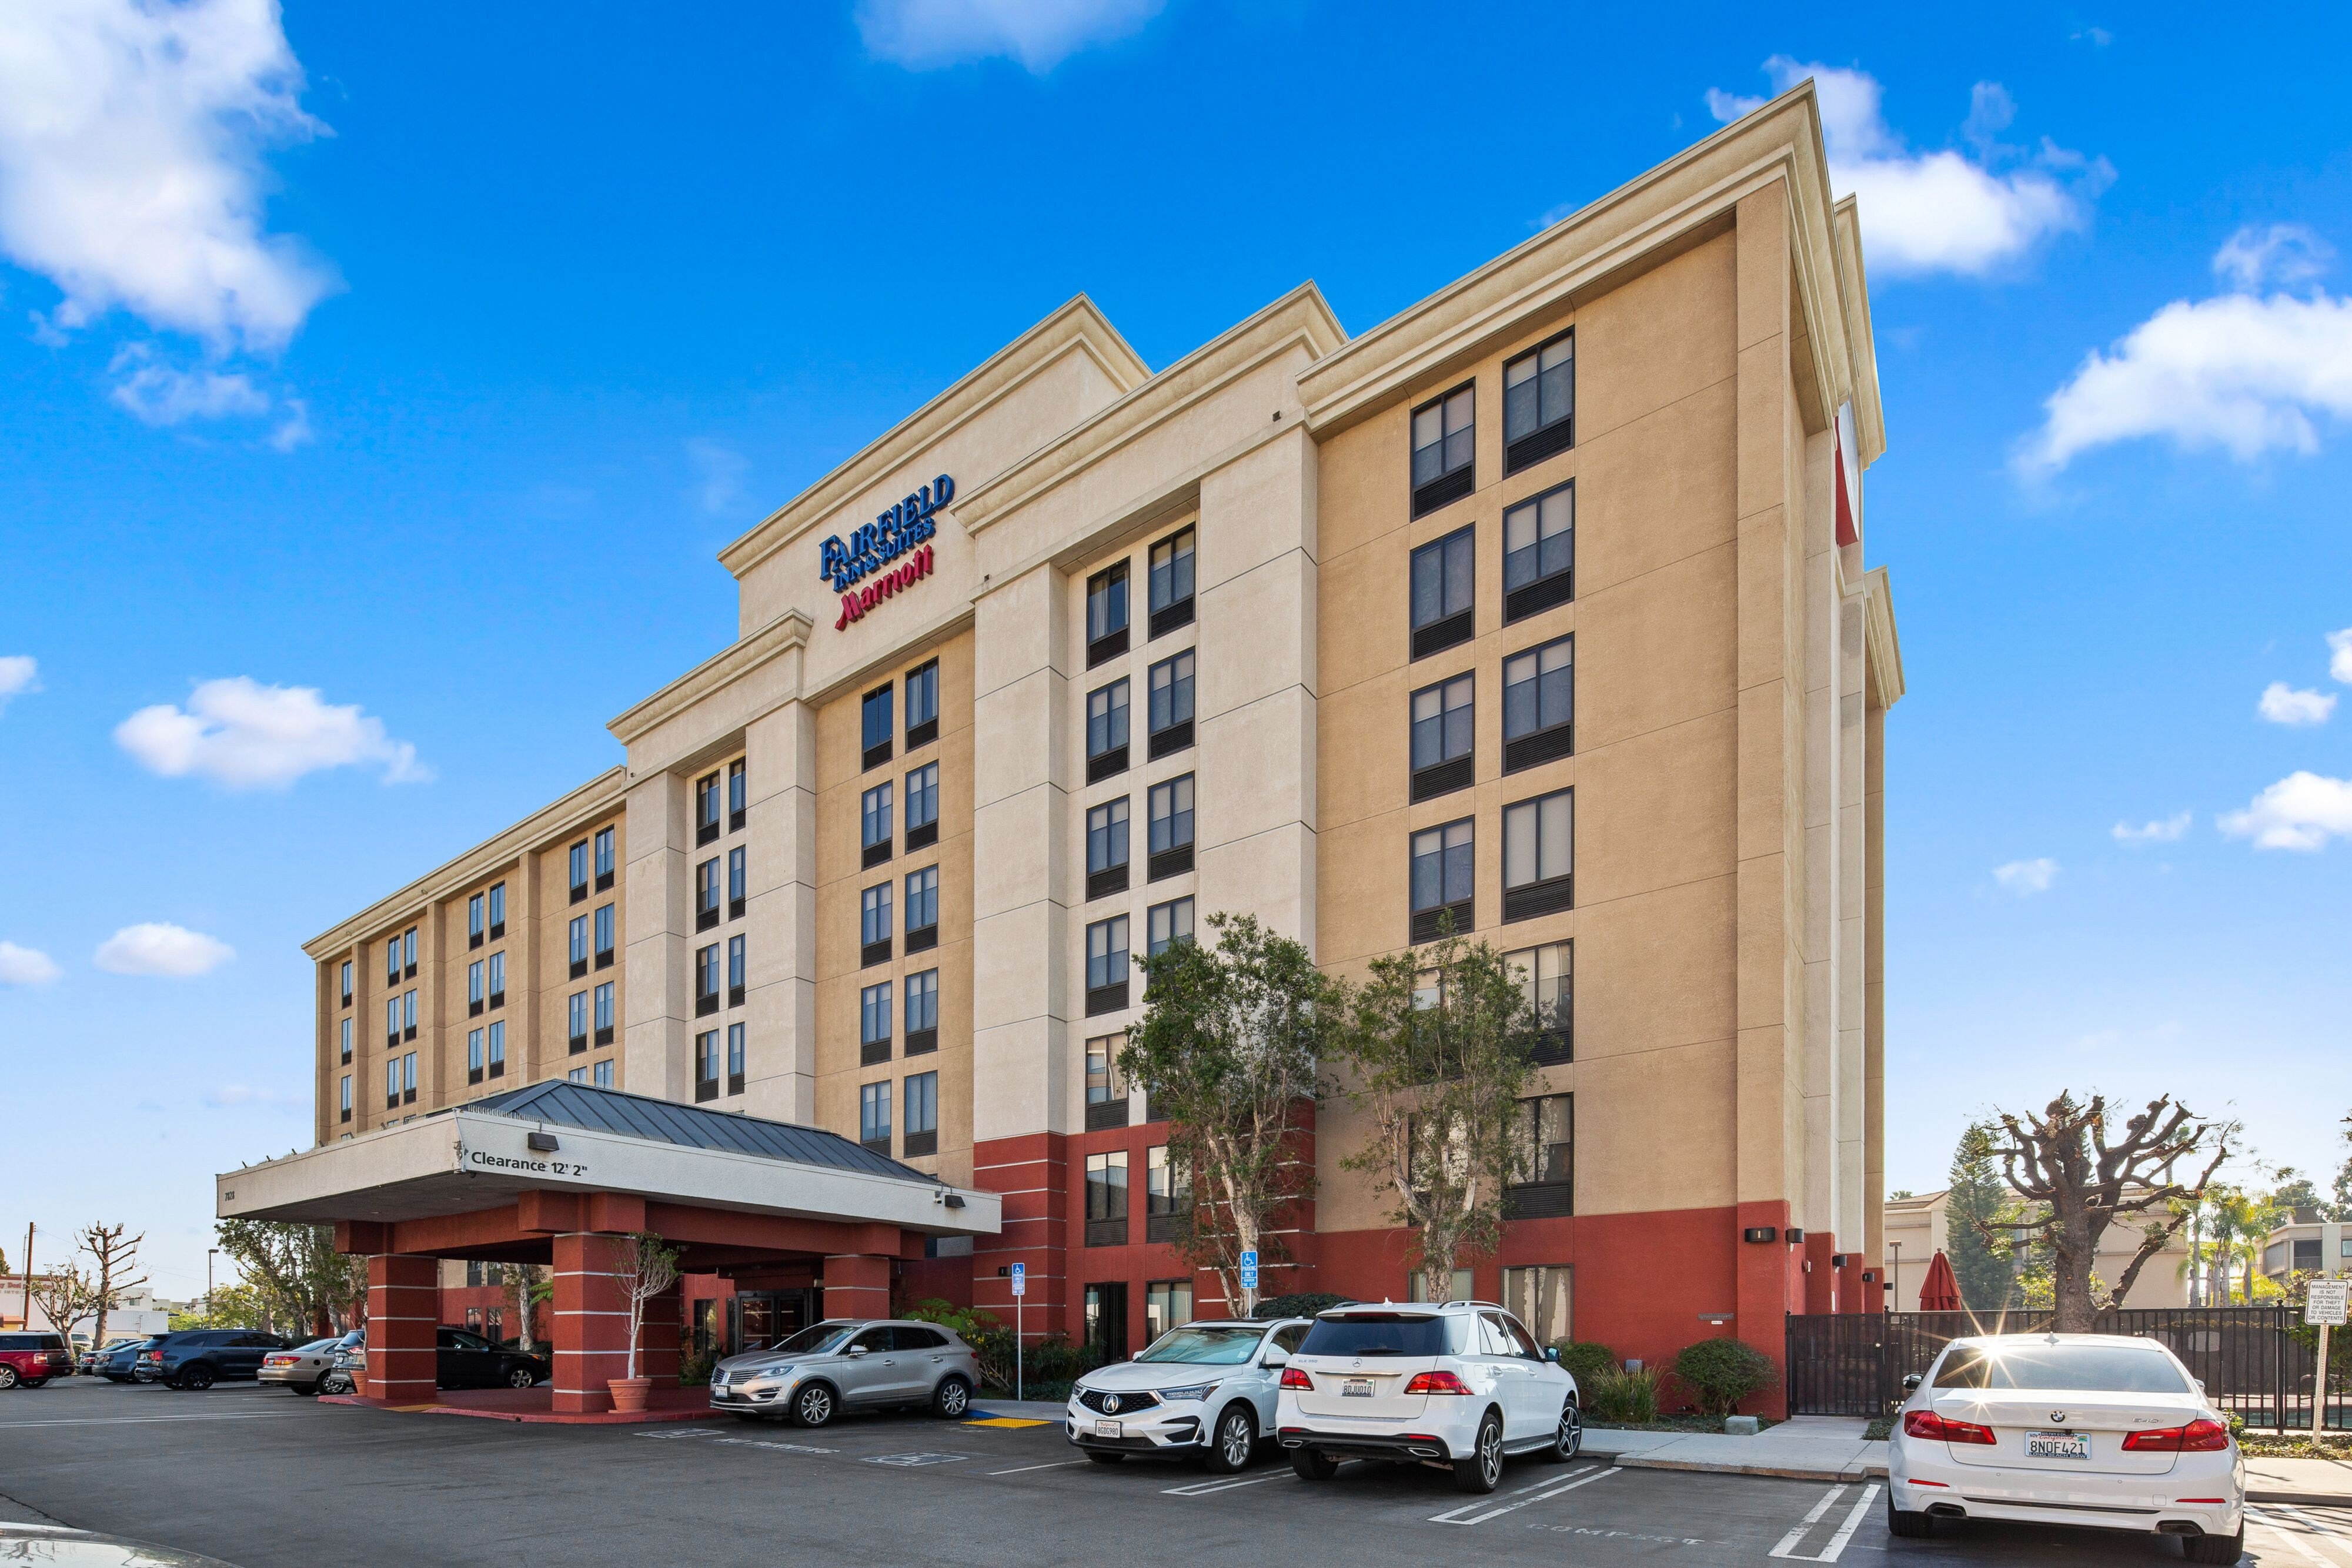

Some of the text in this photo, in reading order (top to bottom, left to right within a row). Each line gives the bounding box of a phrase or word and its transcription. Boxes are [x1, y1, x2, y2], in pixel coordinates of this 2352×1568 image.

[819, 474, 955, 581] FAIRFIELD
[833, 517, 936, 593] INN & SUITES
[835, 544, 934, 631] Marriott
[471, 1151, 546, 1172] Clearance
[1098, 1427, 1118, 1435] 8GDG980
